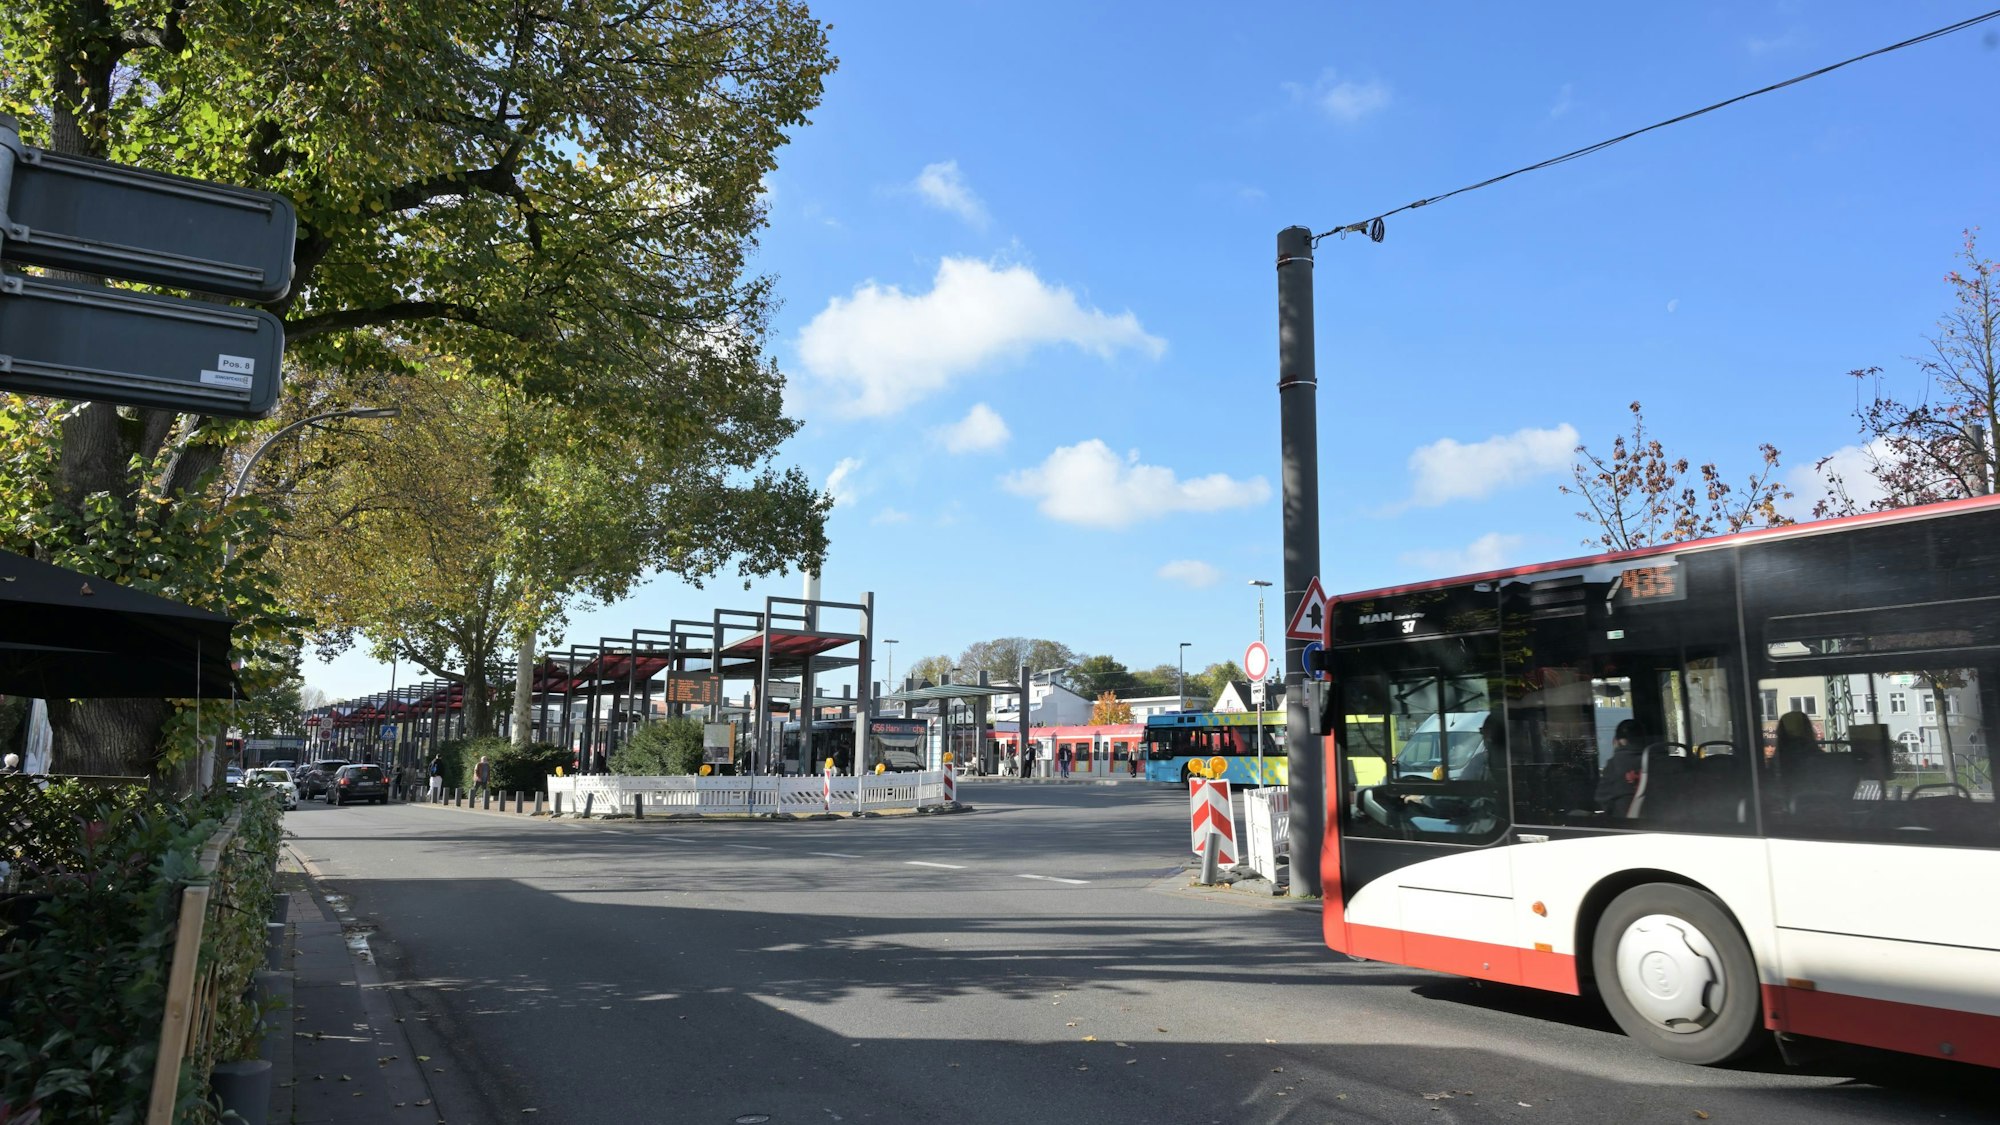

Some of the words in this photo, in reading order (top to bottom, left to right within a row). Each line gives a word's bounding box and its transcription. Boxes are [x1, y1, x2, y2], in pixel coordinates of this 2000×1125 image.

[223, 359, 242, 369] Pos.
[244, 362, 250, 370] 8
[1621, 565, 1675, 599] 435
[1359, 611, 1393, 625] MAN
[1402, 620, 1417, 634] 37
[872, 722, 885, 733] 456
